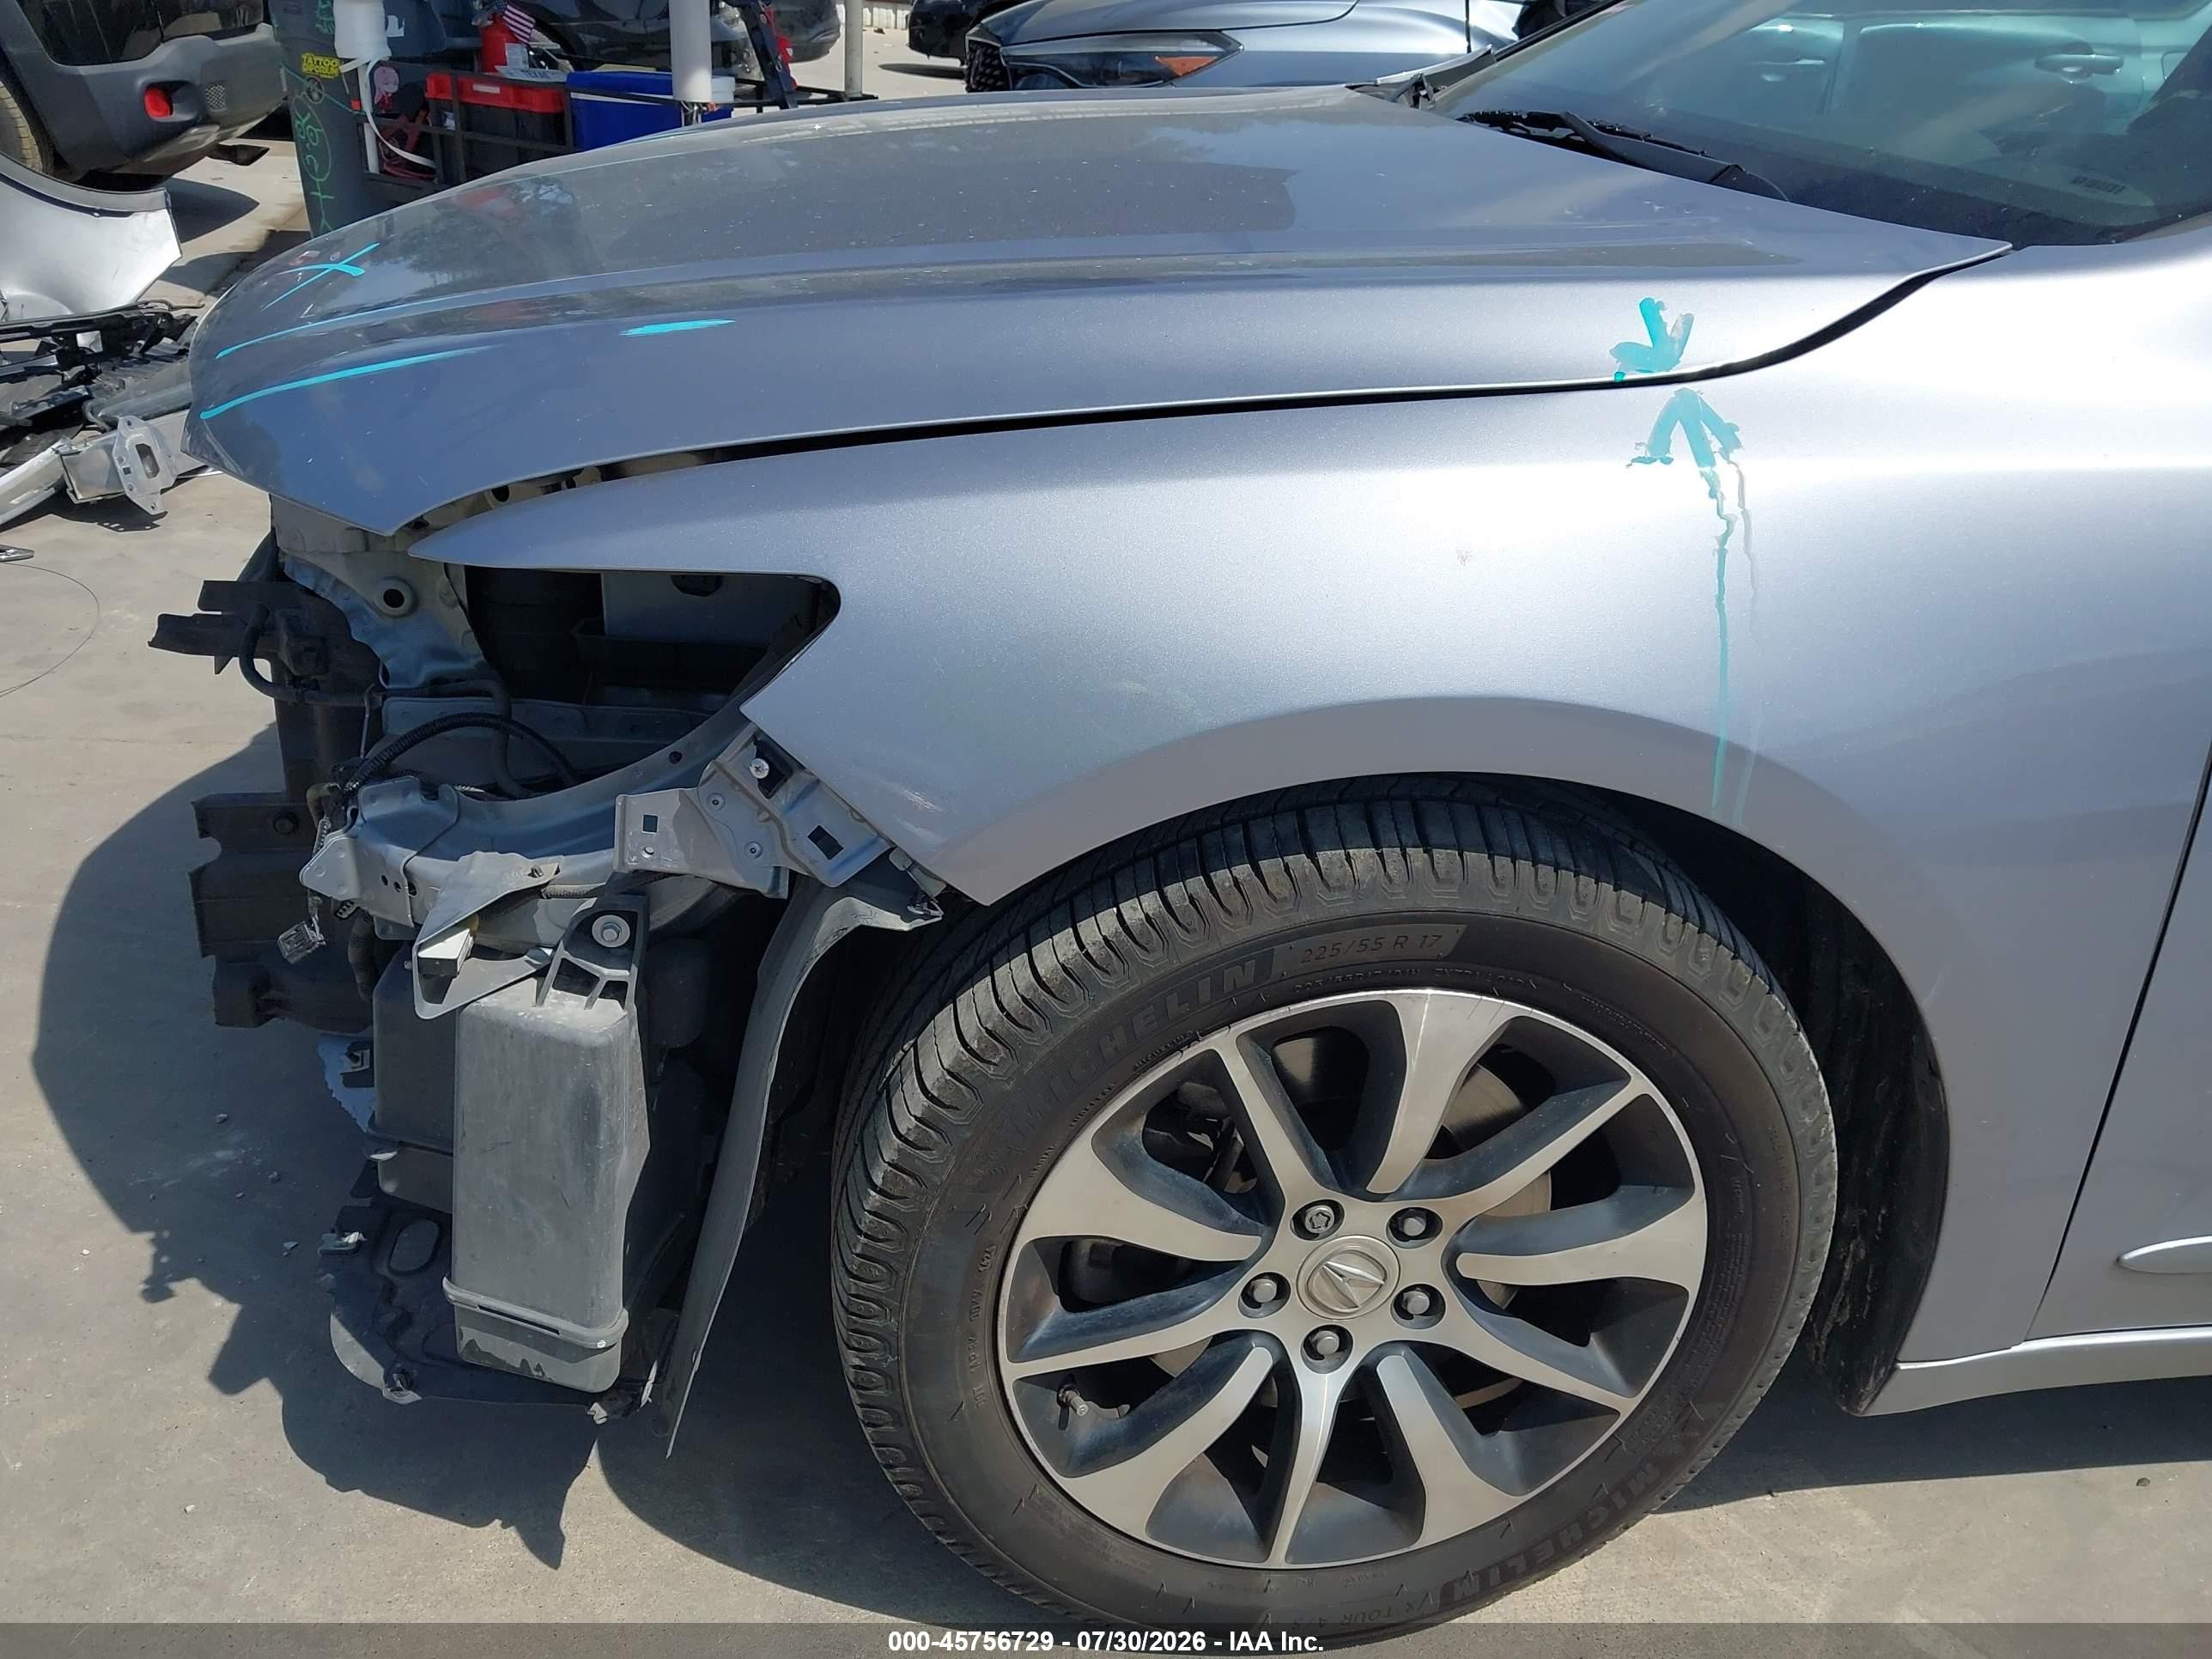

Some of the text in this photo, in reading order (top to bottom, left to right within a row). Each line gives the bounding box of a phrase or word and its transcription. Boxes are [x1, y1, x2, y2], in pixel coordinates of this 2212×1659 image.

[1299, 934, 1443, 963] 225/55 R 17
[1012, 959, 1256, 1140] MICHELIN
[1454, 1463, 1662, 1601] MICHELIN
[1340, 1605, 1393, 1626] TOUR
